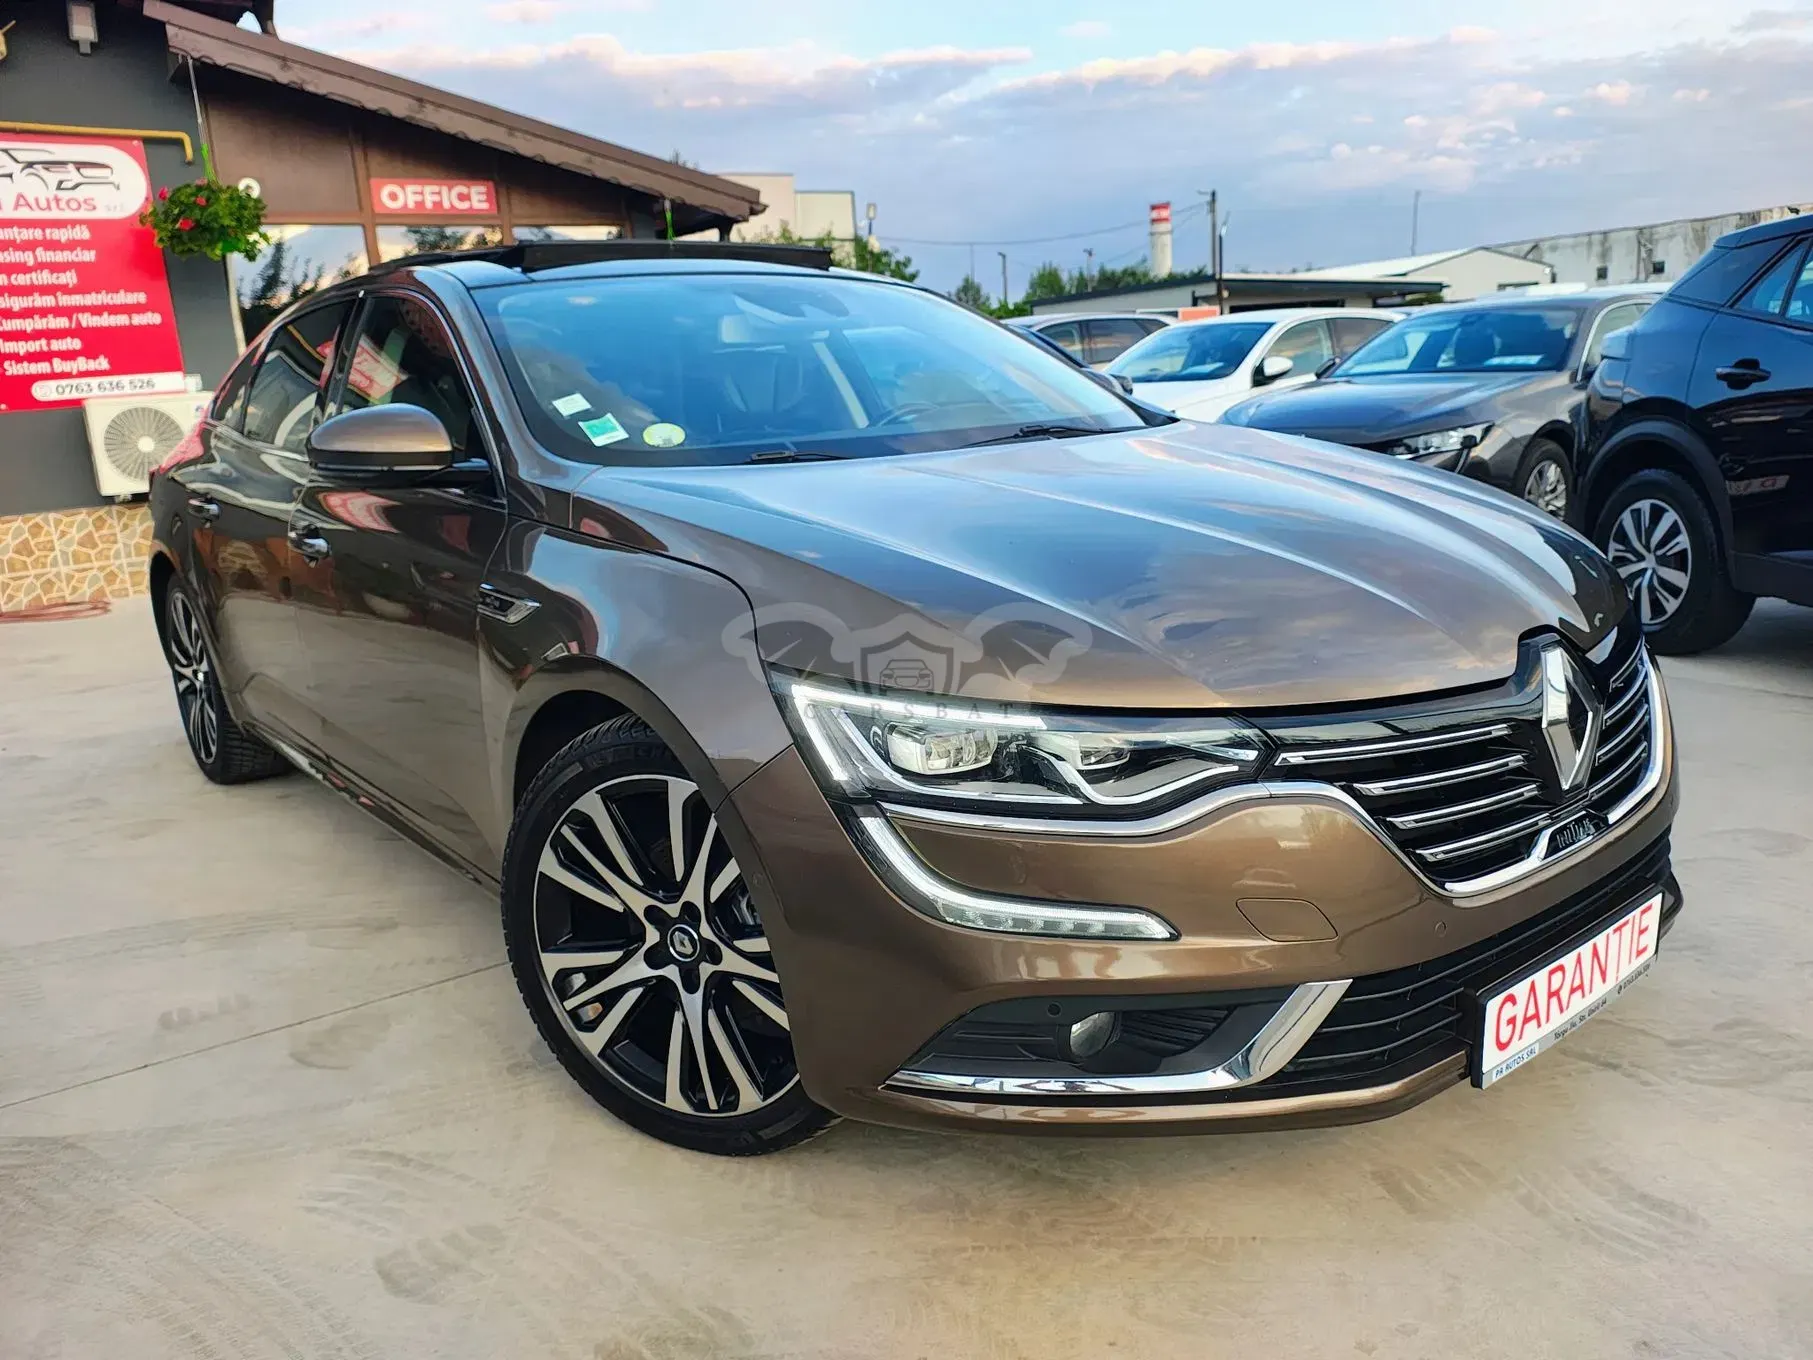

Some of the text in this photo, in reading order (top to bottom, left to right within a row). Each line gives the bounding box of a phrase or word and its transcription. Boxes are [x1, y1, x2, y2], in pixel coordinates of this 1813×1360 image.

[12, 191, 97, 212] Autos
[380, 183, 489, 210] OFFICE
[45, 224, 90, 243] rapidă
[35, 246, 96, 263] financiar
[10, 268, 78, 288] certificați
[56, 289, 147, 308] înmatriculare
[71, 313, 77, 329] /
[77, 311, 130, 328] Vindem
[131, 311, 162, 326] auto
[0, 336, 82, 356] Import auto
[3, 354, 111, 376] Sistem BuyBack
[55, 377, 156, 397] 0763 636 526
[1495, 903, 1653, 1052] GARANTIE
